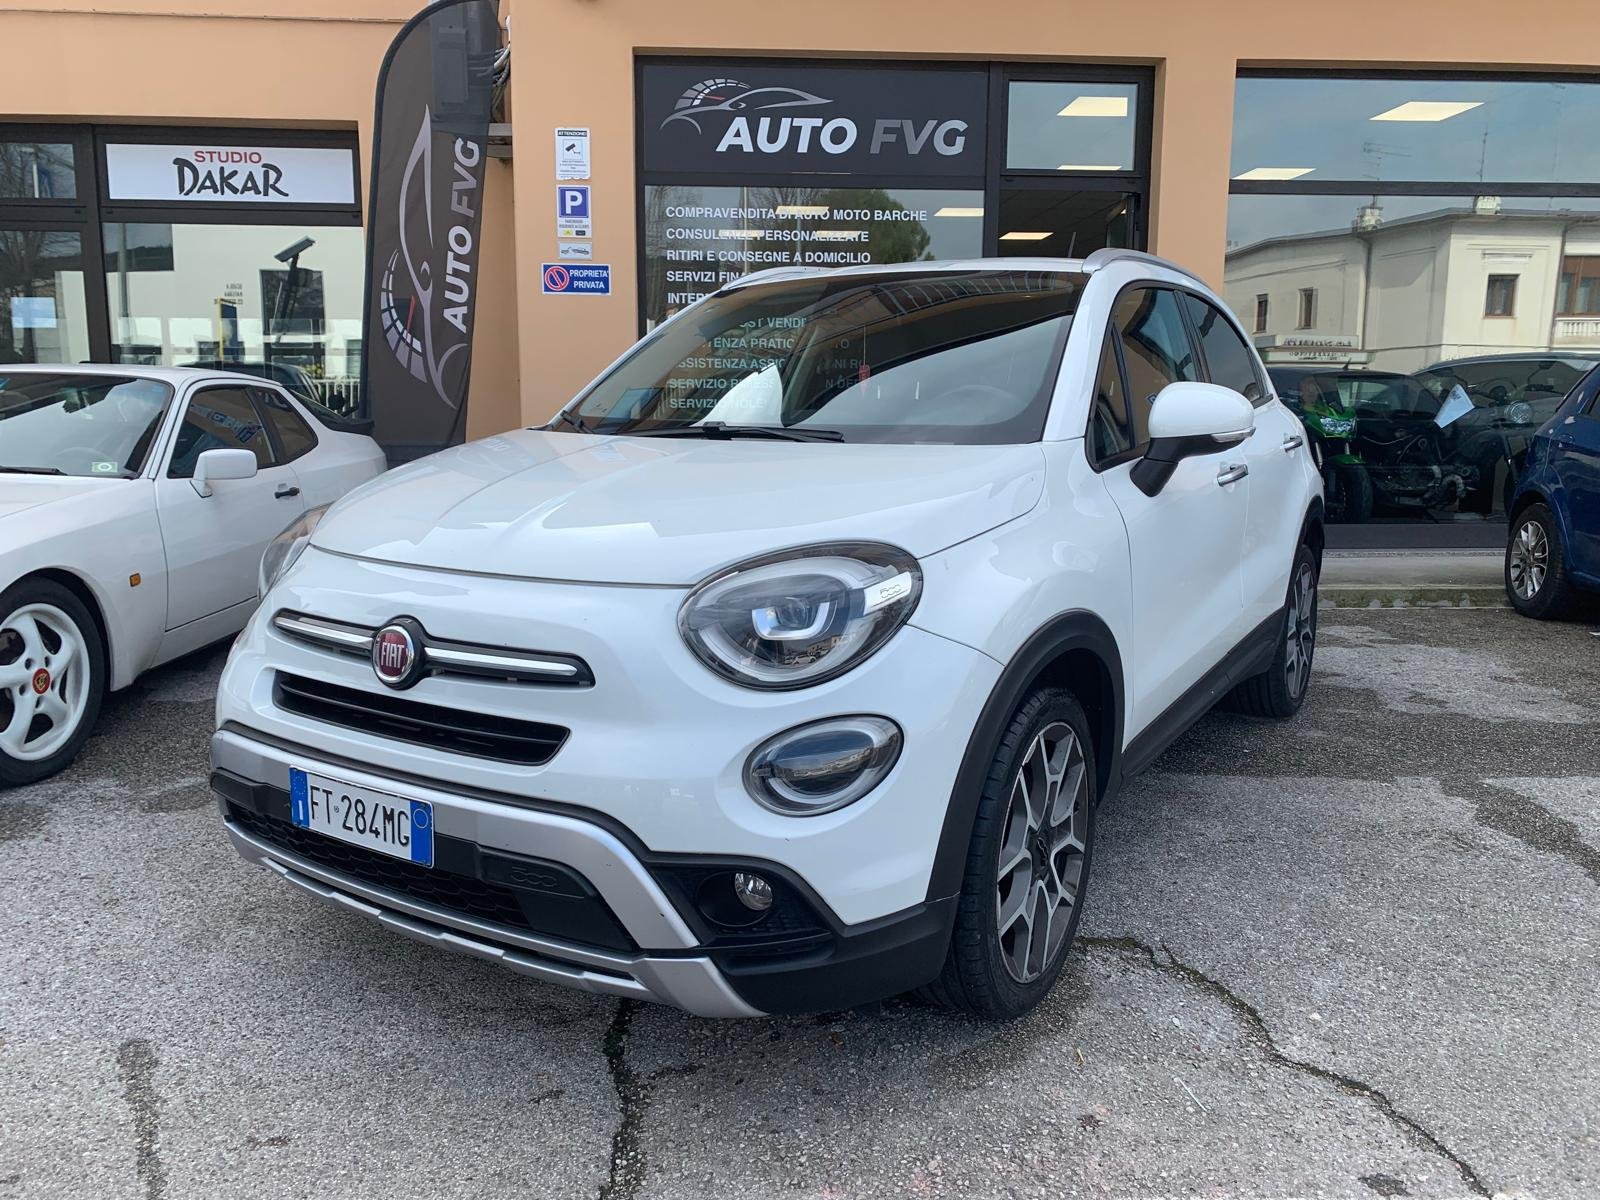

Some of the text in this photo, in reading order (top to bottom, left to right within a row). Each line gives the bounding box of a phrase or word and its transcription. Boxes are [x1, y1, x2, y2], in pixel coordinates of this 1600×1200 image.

[715, 117, 969, 156] AUTO FVG
[194, 150, 262, 164] STUDIO
[172, 157, 290, 197] DAKAR
[565, 191, 583, 214] P
[665, 206, 776, 219] COMPRAVENDITA
[833, 209, 871, 221] MOTO
[874, 210, 928, 221] BARCHE
[442, 136, 480, 334] AUTO FVG
[666, 250, 871, 264] RITIRI E CONSEGNE A DOMICILIO
[666, 271, 715, 282] SERVIZI
[573, 280, 605, 289] PRIVATA
[669, 379, 726, 389] SERVIZIO
[380, 642, 405, 668] FIAT
